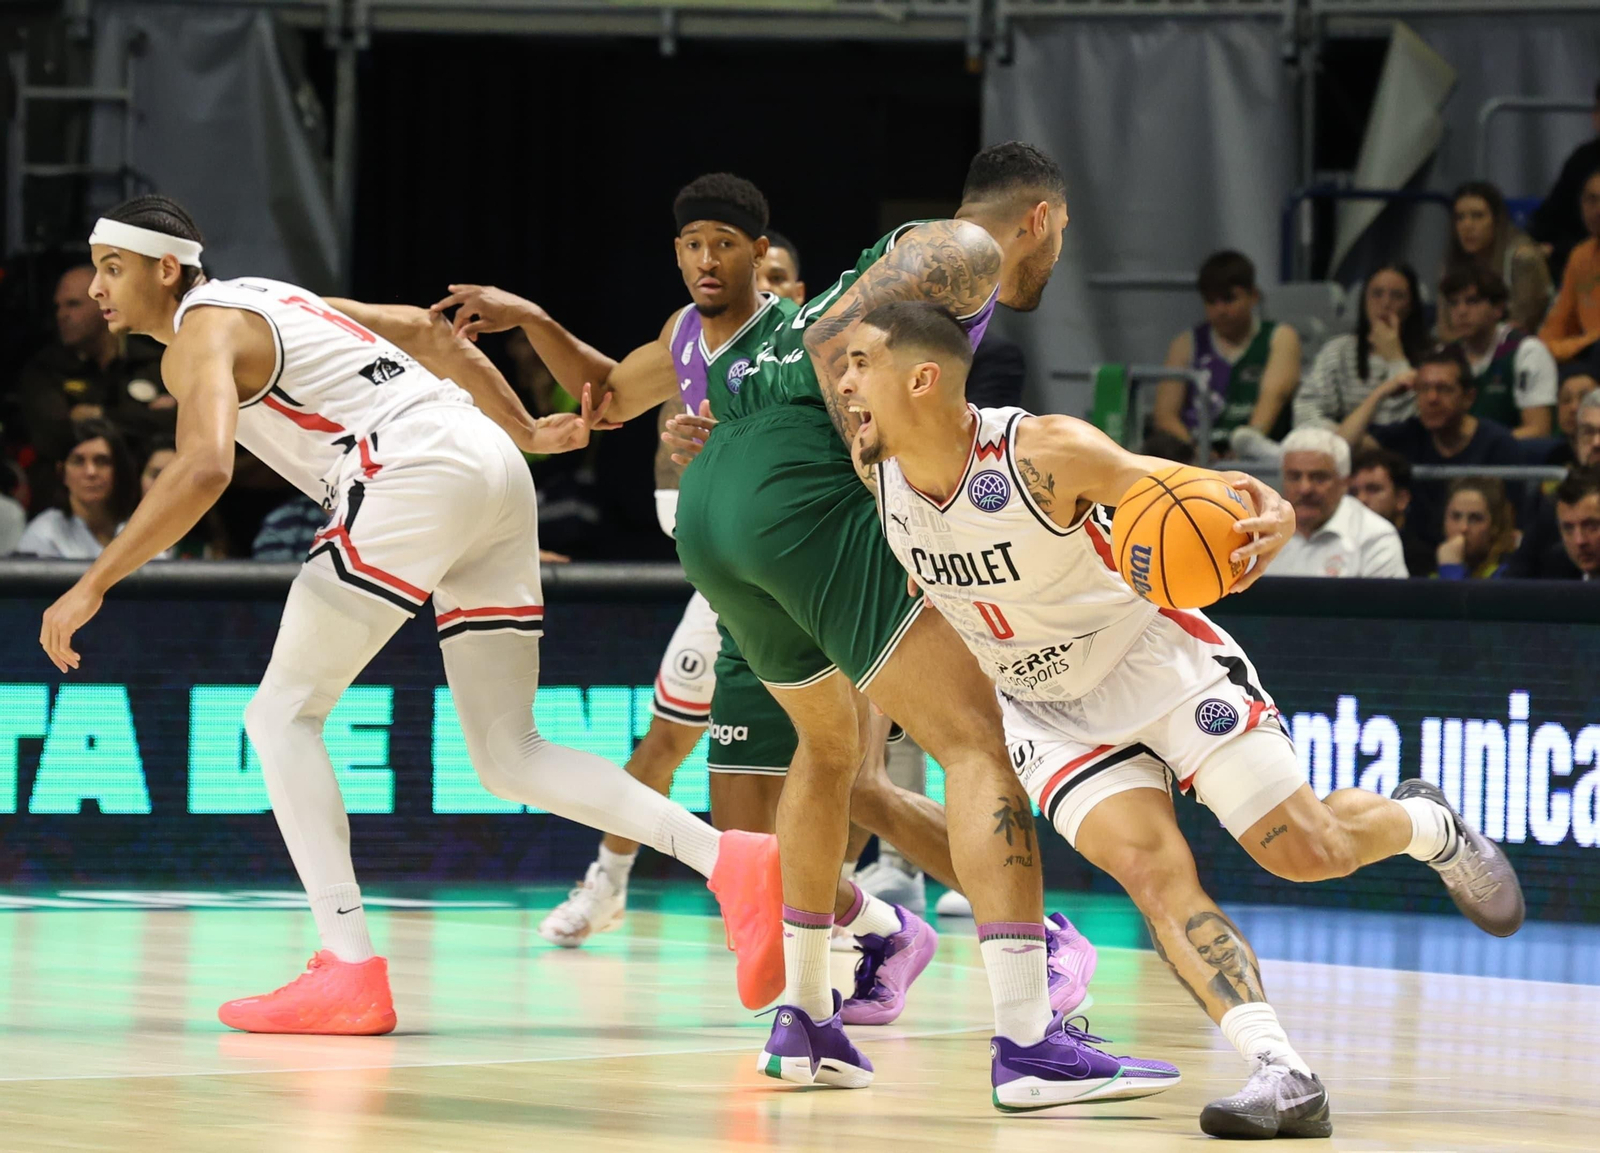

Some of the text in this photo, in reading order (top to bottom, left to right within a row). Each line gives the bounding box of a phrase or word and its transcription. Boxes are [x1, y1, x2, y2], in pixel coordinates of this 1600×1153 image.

[911, 541, 1021, 587] CHOLET
[973, 601, 1014, 640] 0
[1279, 694, 1402, 800] nta
